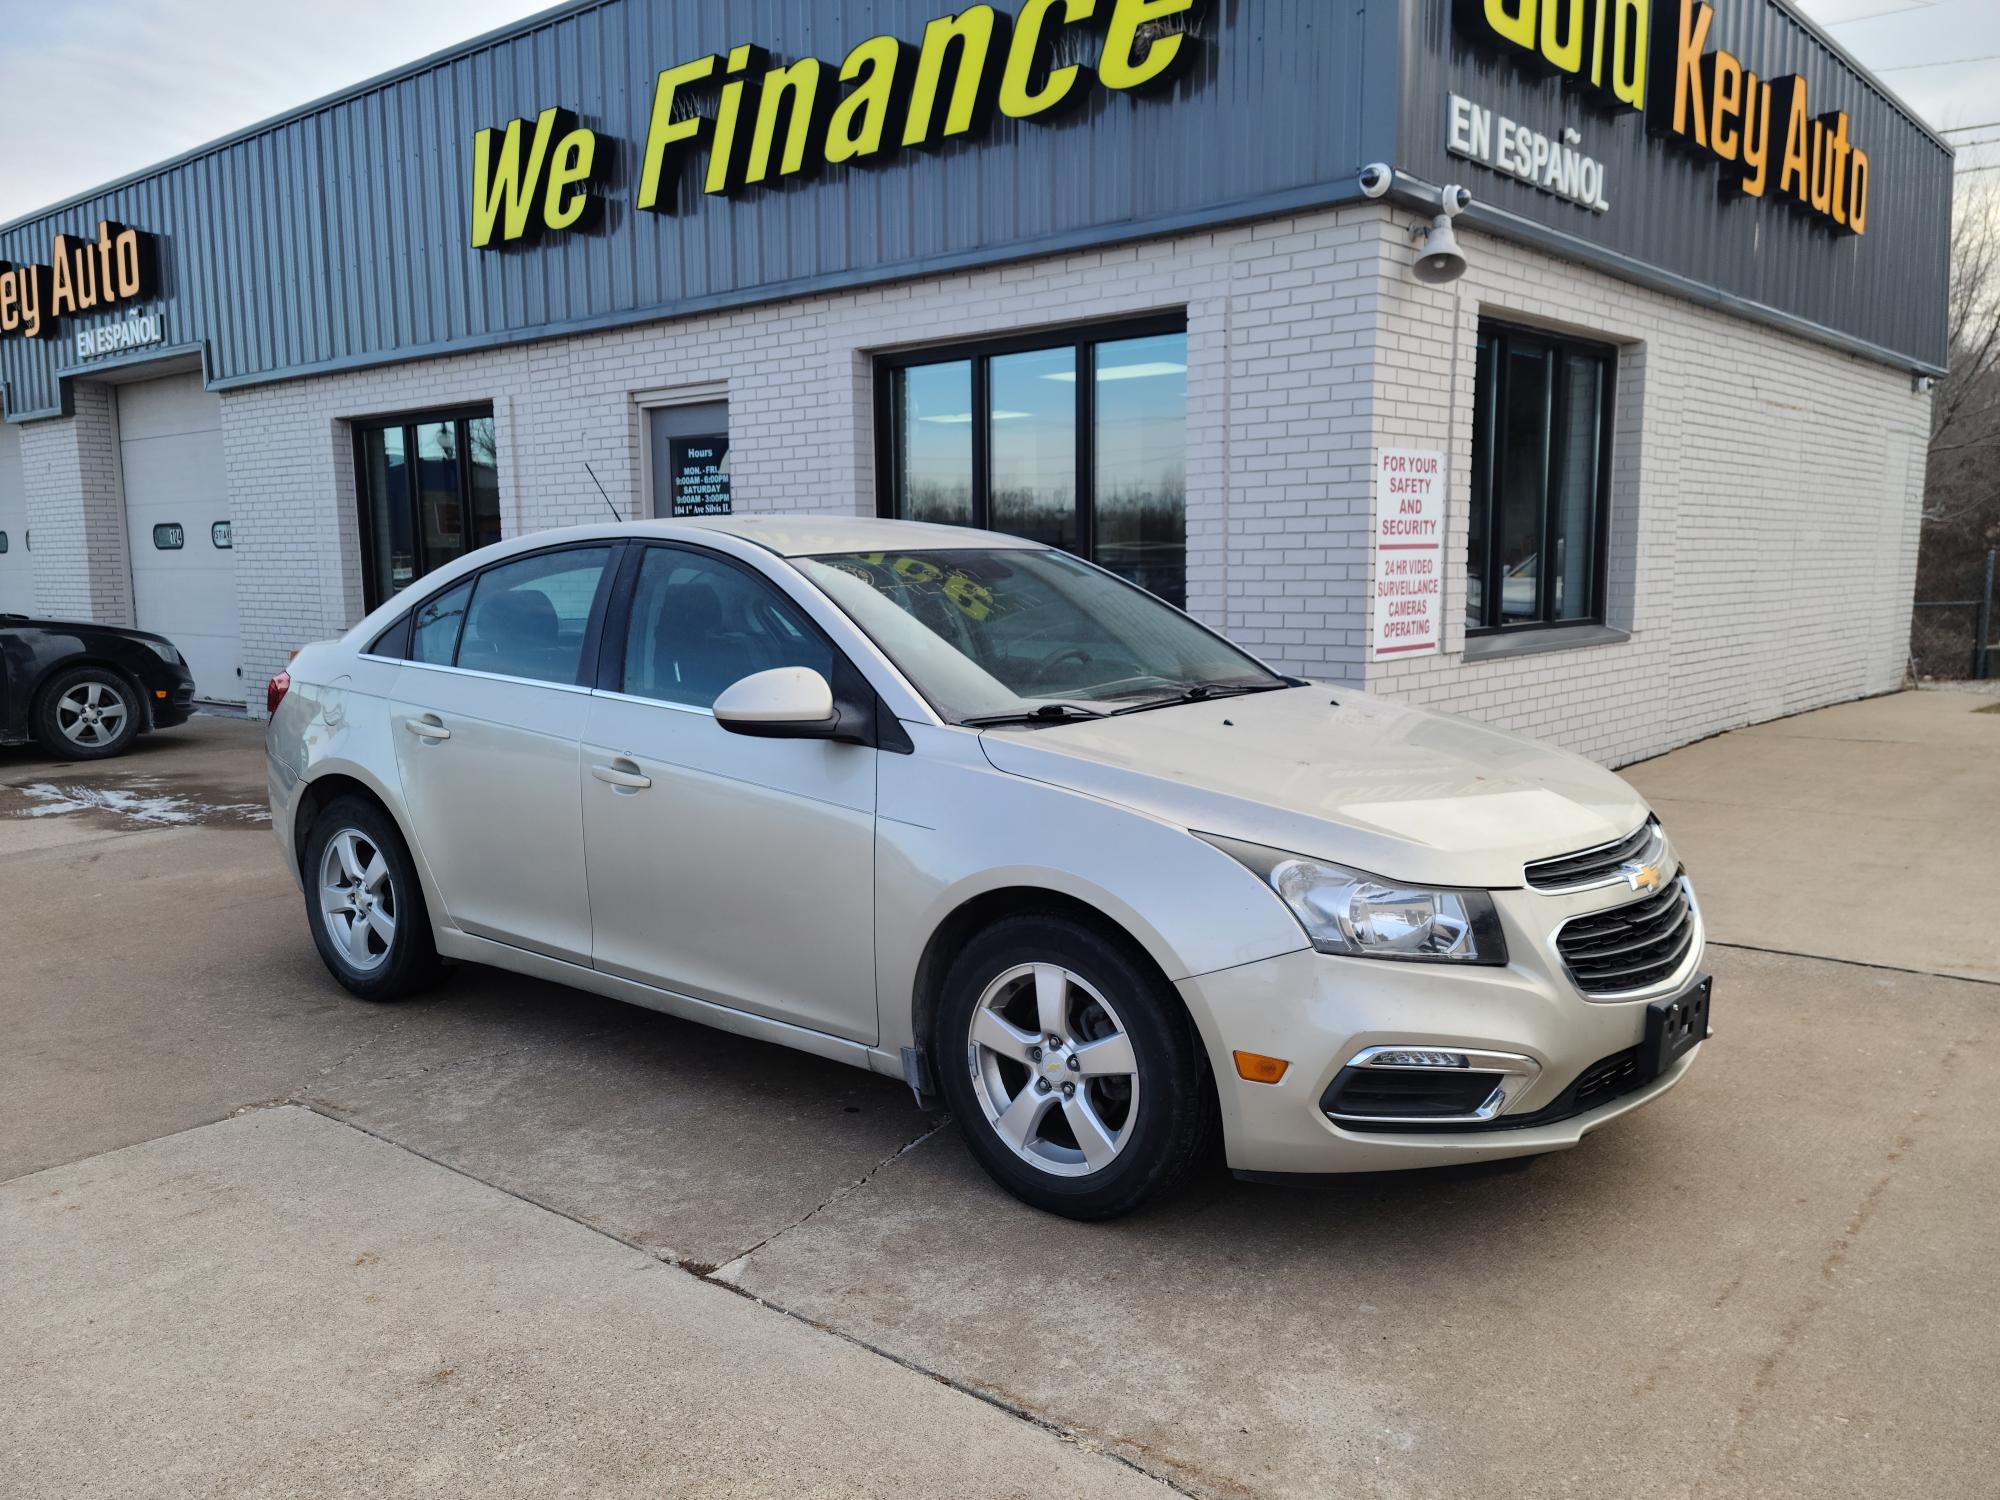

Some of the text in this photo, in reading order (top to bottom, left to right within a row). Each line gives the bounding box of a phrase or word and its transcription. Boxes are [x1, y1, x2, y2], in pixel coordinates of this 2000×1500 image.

[472, 0, 1194, 249] We Finance
[1673, 0, 1771, 197] Key
[1780, 75, 1869, 236] Auto
[1450, 96, 1609, 211] EN ESPAÑOL
[0, 220, 140, 338] ey Auto
[77, 308, 160, 356] EN ESPAÑOL
[688, 448, 713, 458] Hours
[683, 466, 702, 475] MON.
[1384, 455, 1437, 474] FOR YOUR
[675, 476, 701, 485] 9:00AM
[704, 475, 729, 484] 6:00PM
[1390, 477, 1431, 494] SAFETY
[683, 484, 721, 494] SATURDAY
[676, 494, 701, 504] 9:00AM
[705, 493, 730, 503] 3:00PM
[1399, 498, 1422, 514] AND
[693, 505, 704, 514] Ave
[1382, 519, 1436, 535] SECURITY
[1385, 559, 1433, 576] 24 HR VIDEO
[1378, 578, 1438, 597] SURVEILLANCE
[1388, 599, 1427, 617] CAMERAS
[1384, 619, 1430, 638] OPERATING
